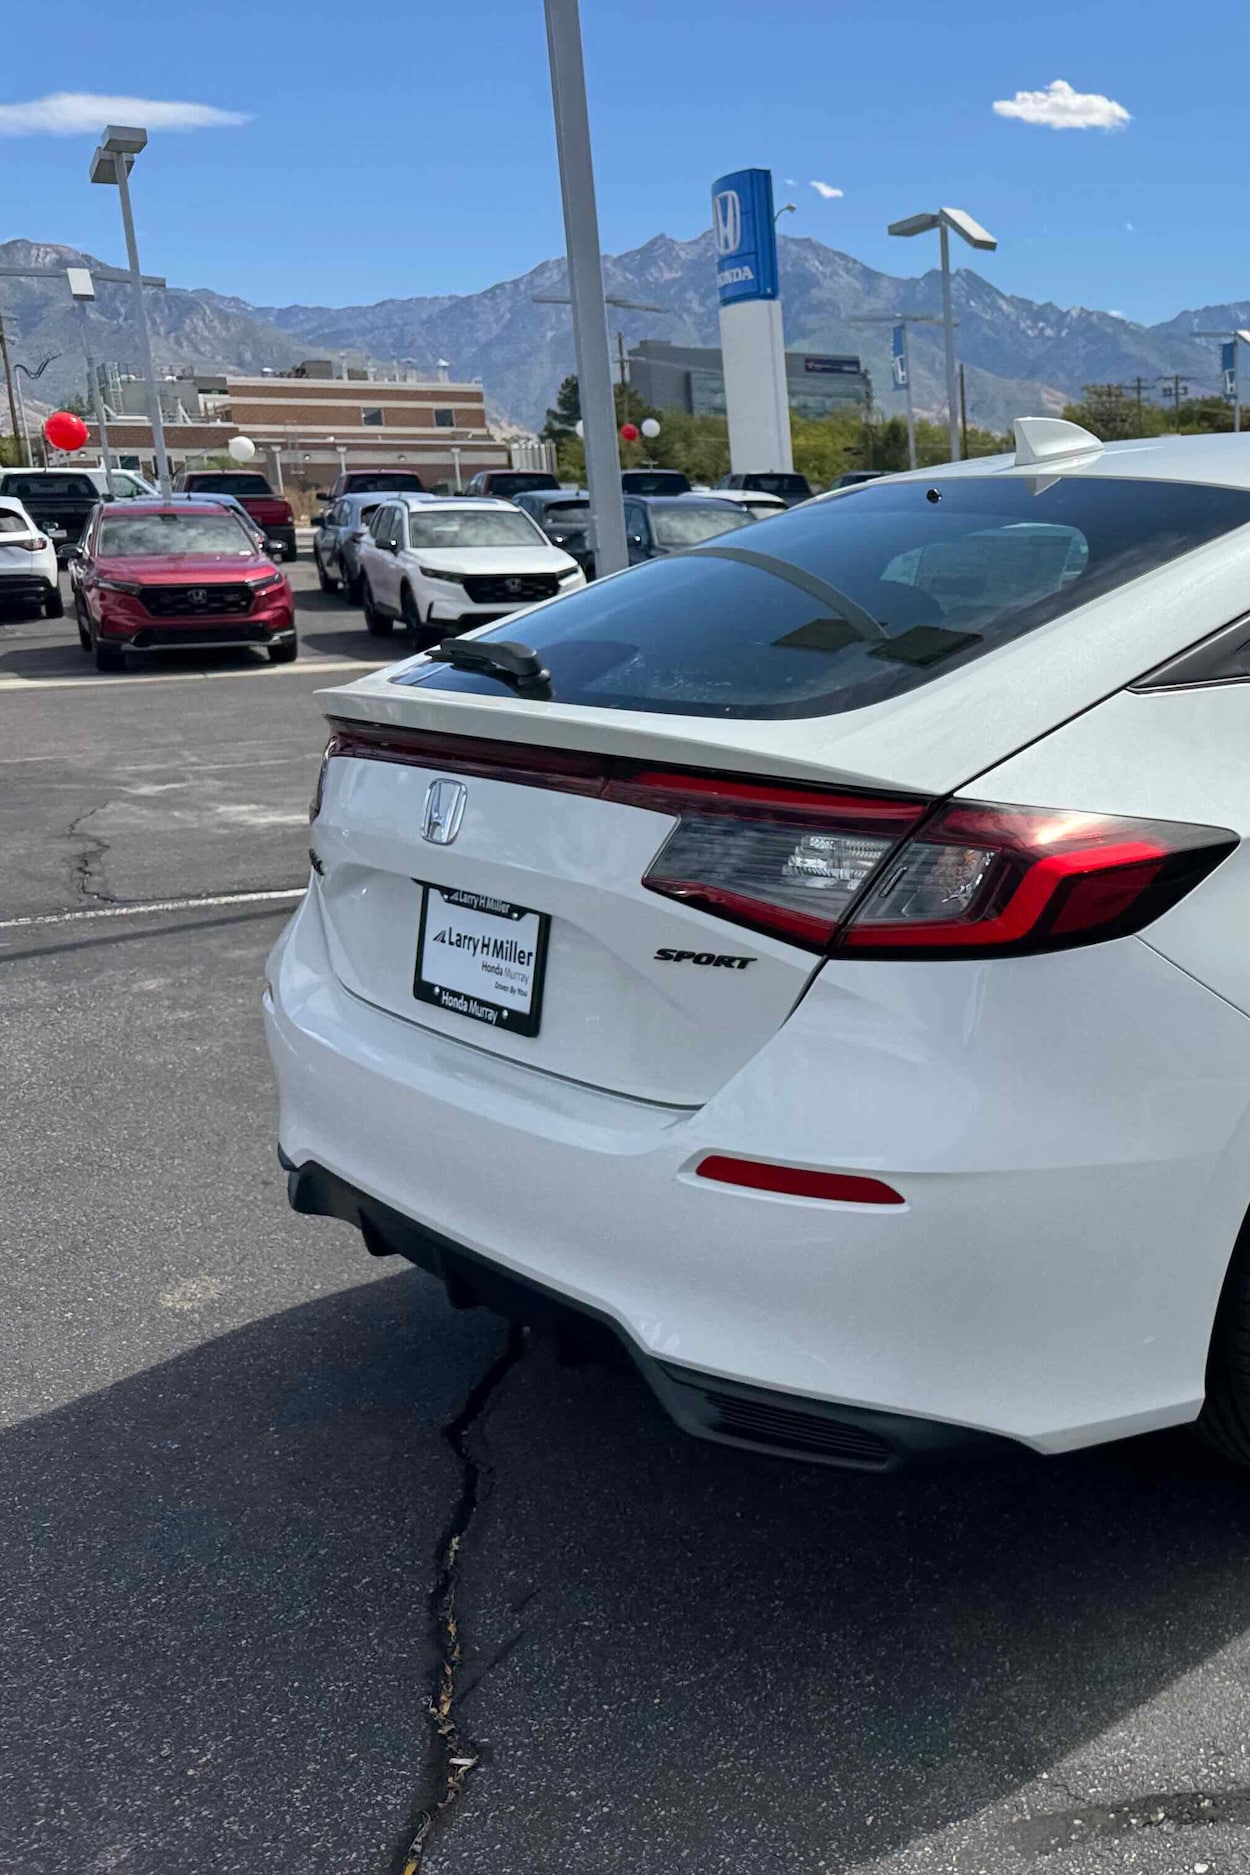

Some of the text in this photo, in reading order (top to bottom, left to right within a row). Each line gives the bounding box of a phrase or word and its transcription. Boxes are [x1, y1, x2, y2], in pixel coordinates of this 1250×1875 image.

[459, 891, 511, 913] Larry H Miller
[448, 926, 533, 966] Larry H Miller
[653, 947, 758, 970] SPORT
[481, 961, 529, 985] Honda Murray
[441, 990, 498, 1024] Honda Murray
